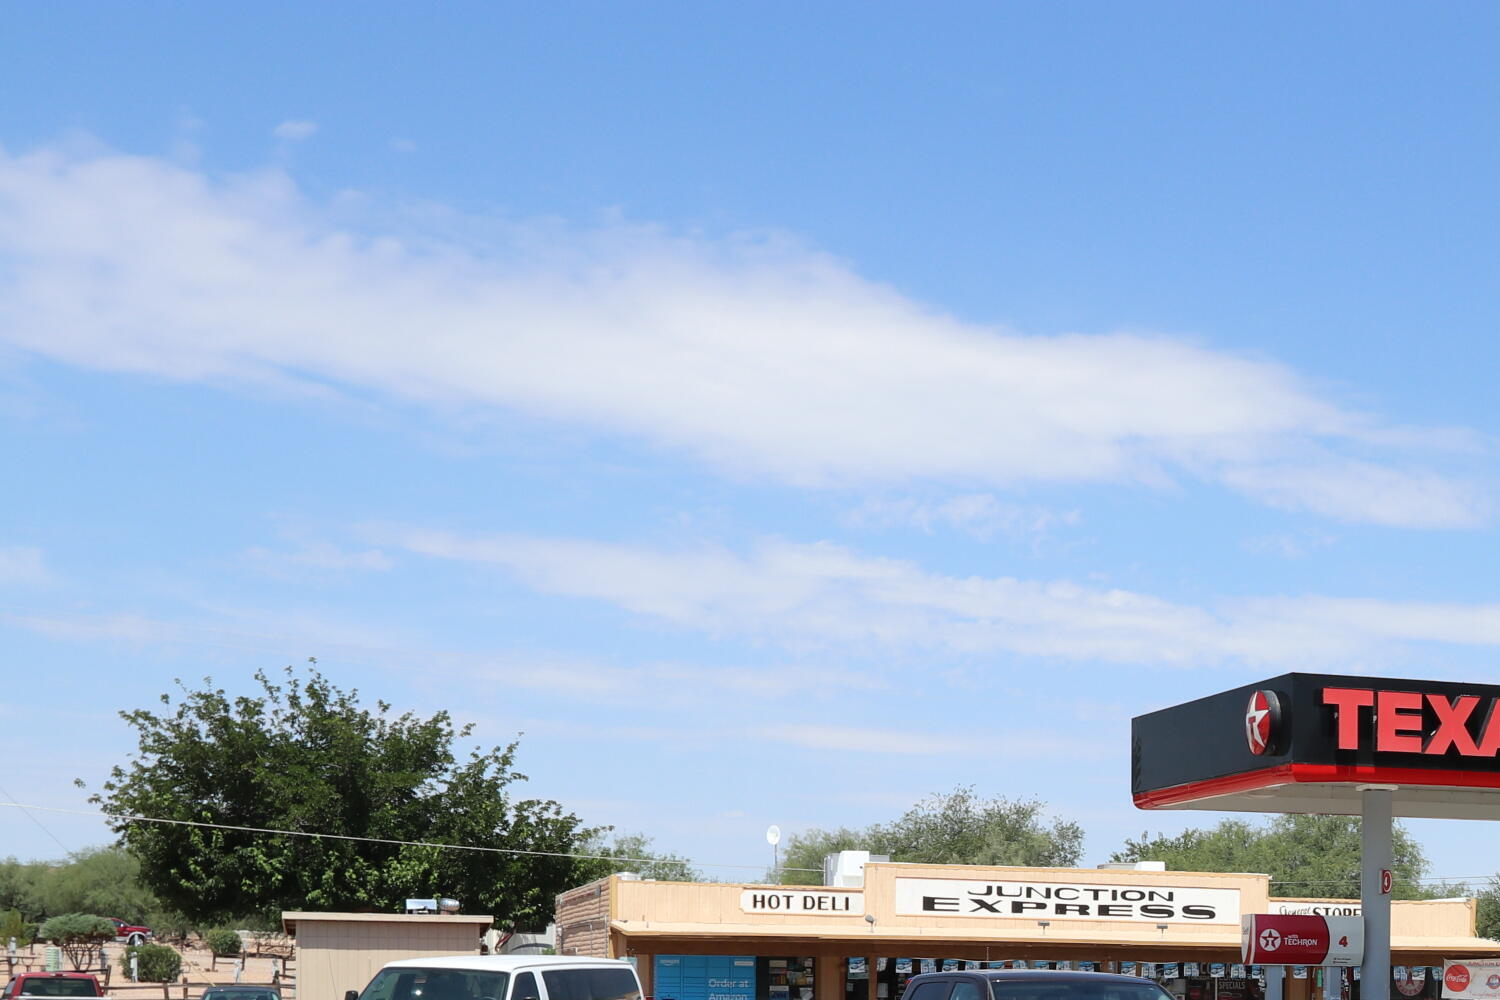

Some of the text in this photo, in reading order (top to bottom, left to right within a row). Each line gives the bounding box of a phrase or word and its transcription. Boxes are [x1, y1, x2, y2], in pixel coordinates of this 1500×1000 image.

[967, 885, 1174, 902] JUNCTION
[753, 894, 850, 911] HOT DELI
[922, 896, 1217, 920] EXPRESS
[1283, 937, 1318, 946] TECHRON
[1338, 935, 1348, 947] 4
[708, 979, 749, 988] Order at
